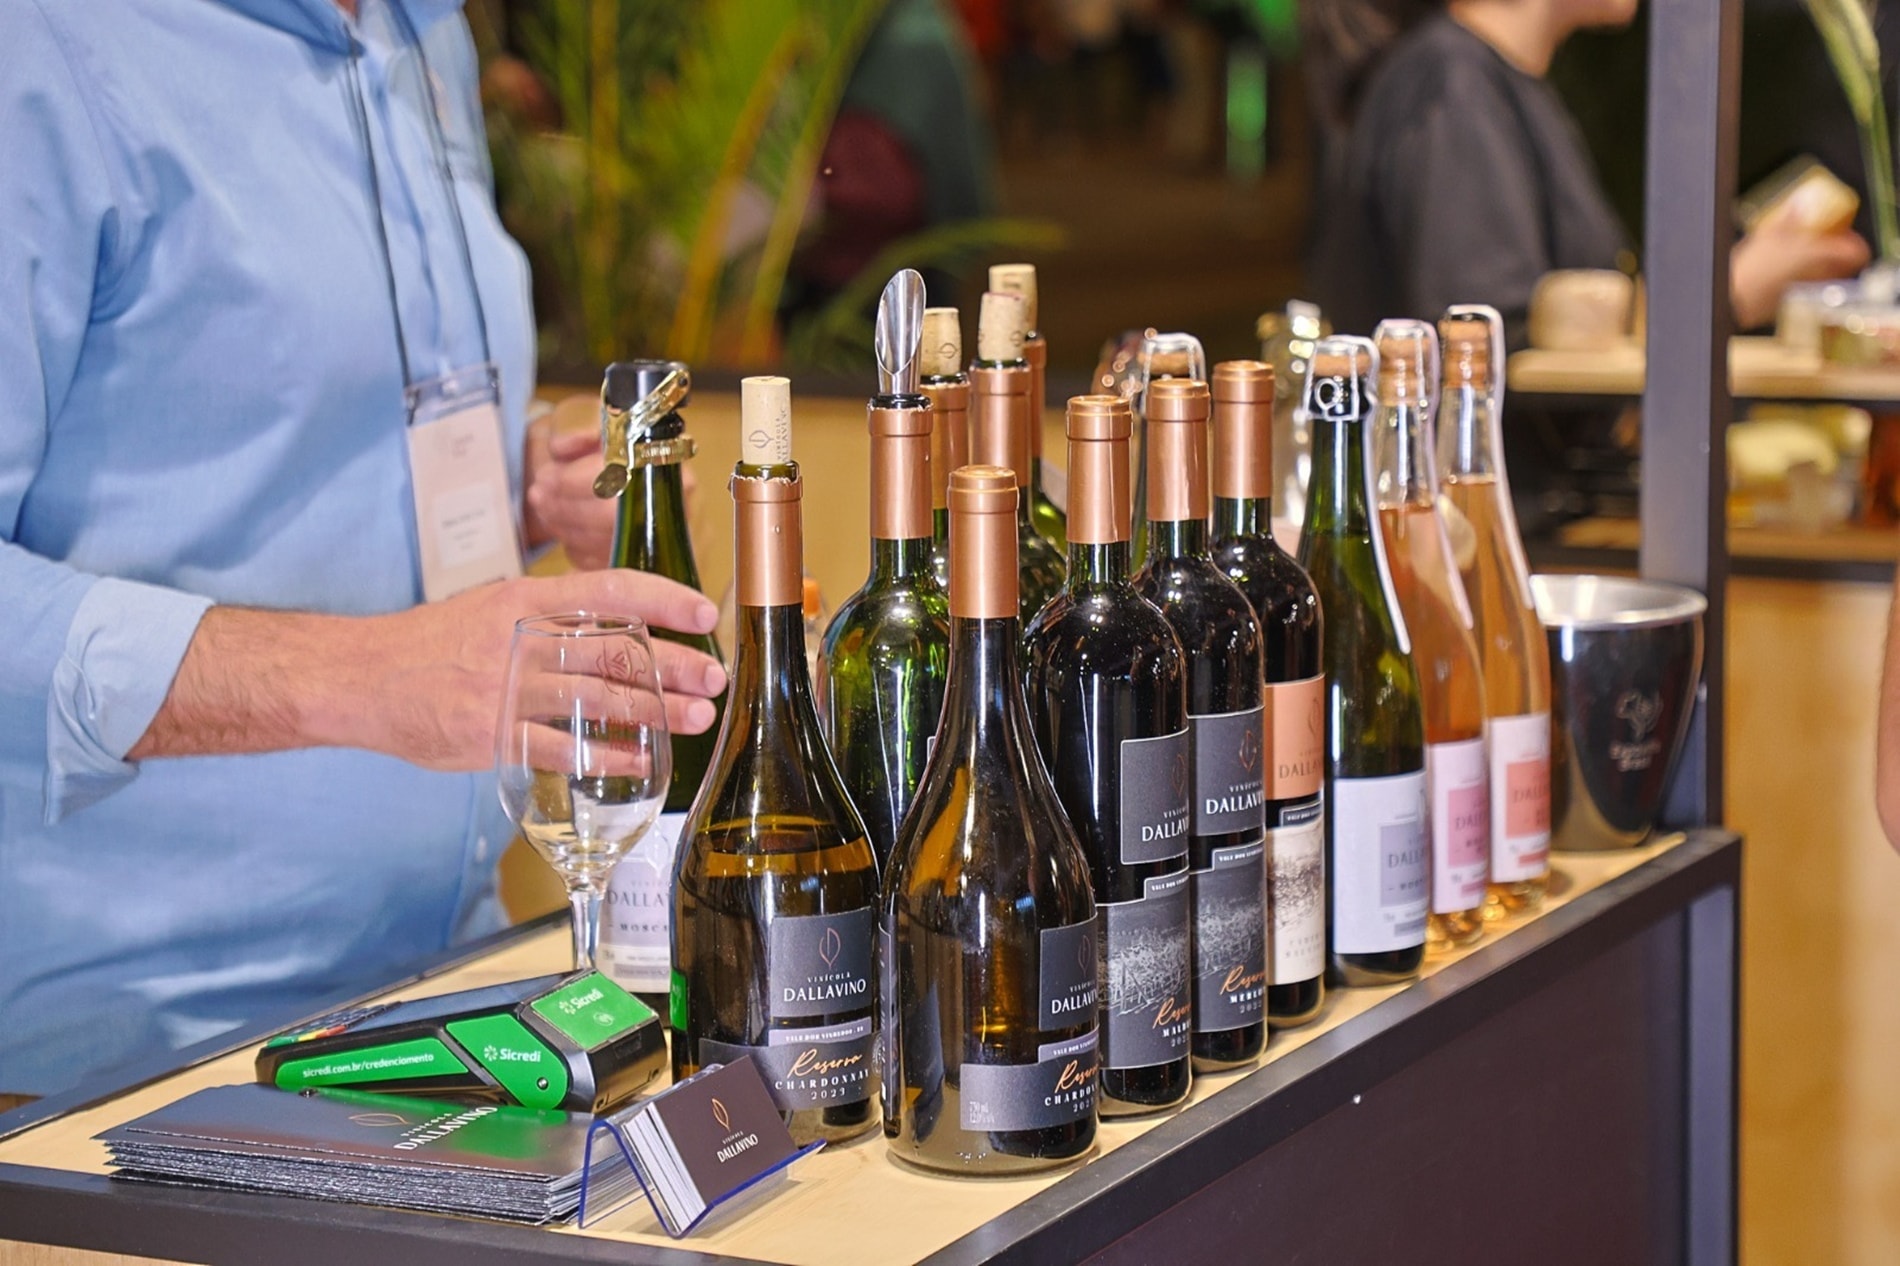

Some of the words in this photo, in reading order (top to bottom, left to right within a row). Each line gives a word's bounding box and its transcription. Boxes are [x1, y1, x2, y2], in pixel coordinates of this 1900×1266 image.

[607, 889, 670, 908] DALLA
[570, 988, 604, 1009] Sicredi
[783, 978, 867, 1003] DALLAVINO
[1230, 986, 1266, 1004] MERLO
[499, 1048, 541, 1063] Sicredi
[787, 1048, 863, 1079] Reserva
[393, 1106, 498, 1151] DALLAVINO
[716, 1133, 759, 1163] DALLAVINO
